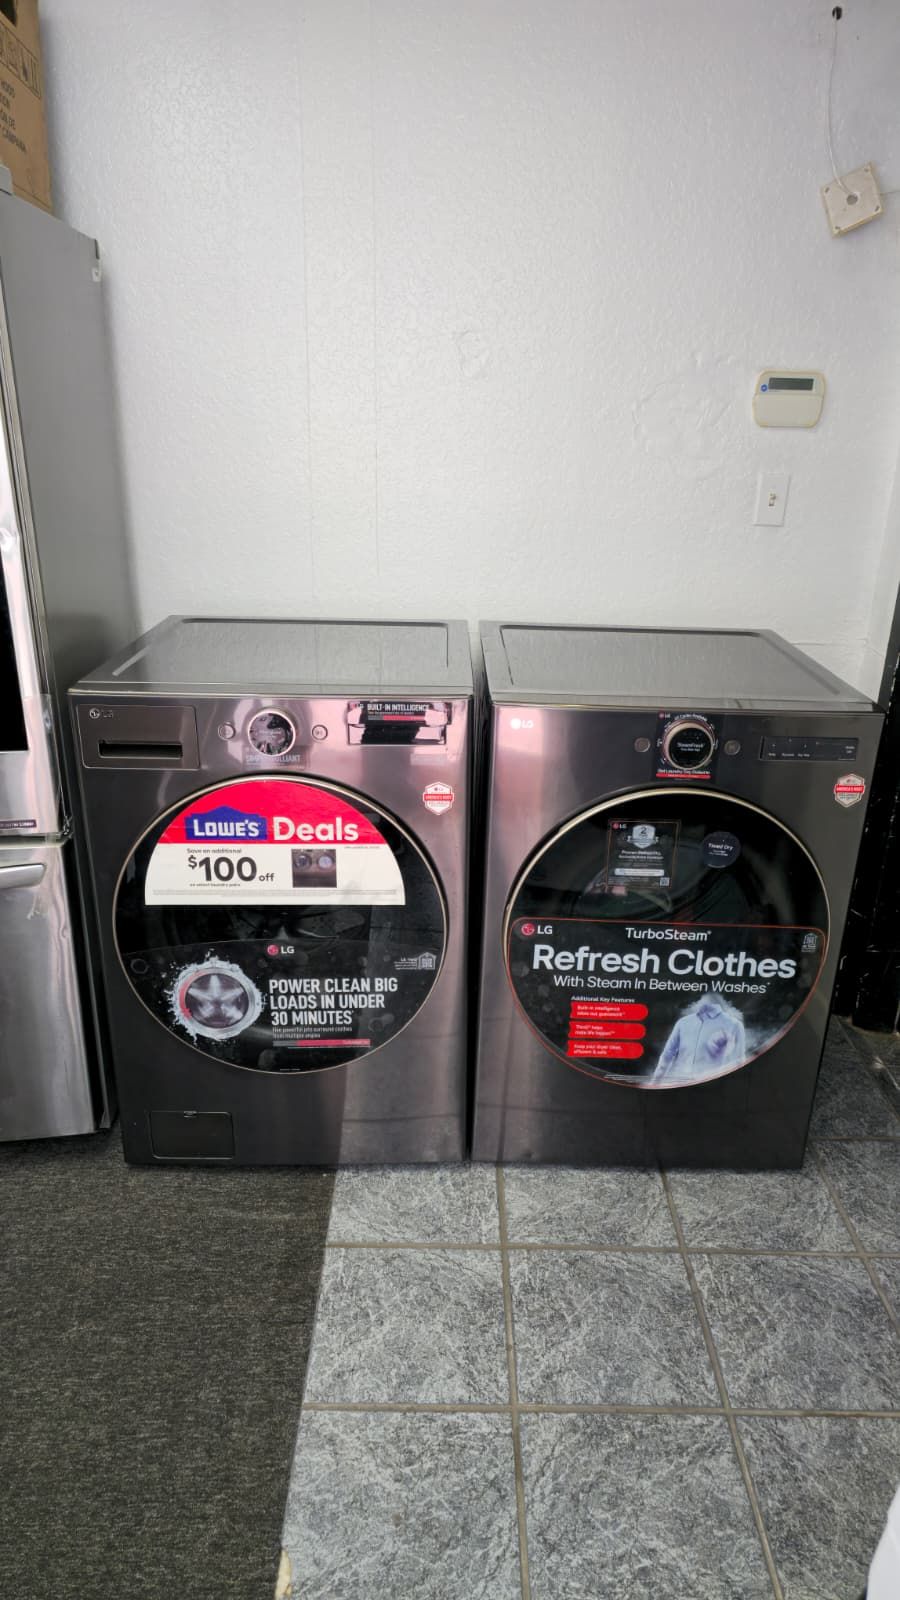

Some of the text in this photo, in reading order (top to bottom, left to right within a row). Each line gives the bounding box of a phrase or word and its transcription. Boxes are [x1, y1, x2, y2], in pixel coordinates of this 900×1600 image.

[522, 720, 534, 729] LG
[193, 816, 359, 842] LOWE'S Deals
[188, 855, 275, 882] $100 off
[537, 925, 553, 936] LG
[280, 946, 295, 954] LG
[532, 944, 797, 979] Refresh Clothes
[269, 977, 399, 994] POWER CLEAN BIG
[554, 975, 584, 988] With
[586, 976, 633, 990] Steam
[635, 978, 647, 990] In
[649, 979, 710, 993] Between
[270, 994, 386, 1010] LOADS IN UNDER
[271, 1011, 288, 1026] 30
